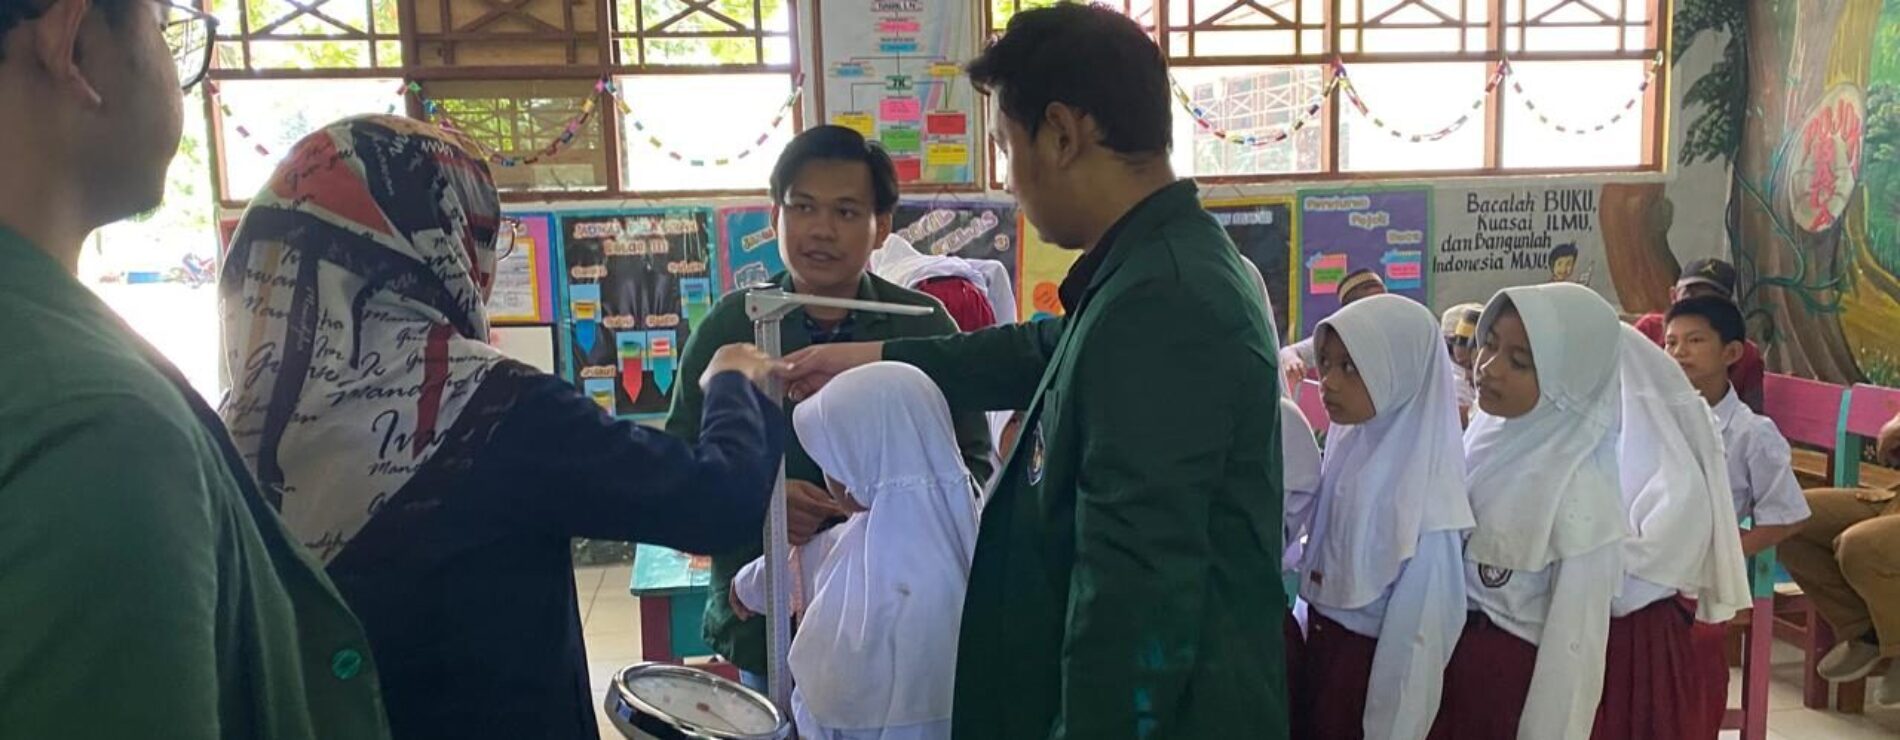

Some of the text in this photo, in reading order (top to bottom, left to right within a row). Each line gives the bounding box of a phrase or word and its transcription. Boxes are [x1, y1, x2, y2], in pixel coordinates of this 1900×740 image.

[1467, 189, 1597, 213] Bacalah BUKU,
[1477, 214, 1533, 232] Kuasai
[1441, 231, 1552, 254] dan Bangunlah
[1432, 255, 1504, 273] Indonesia
